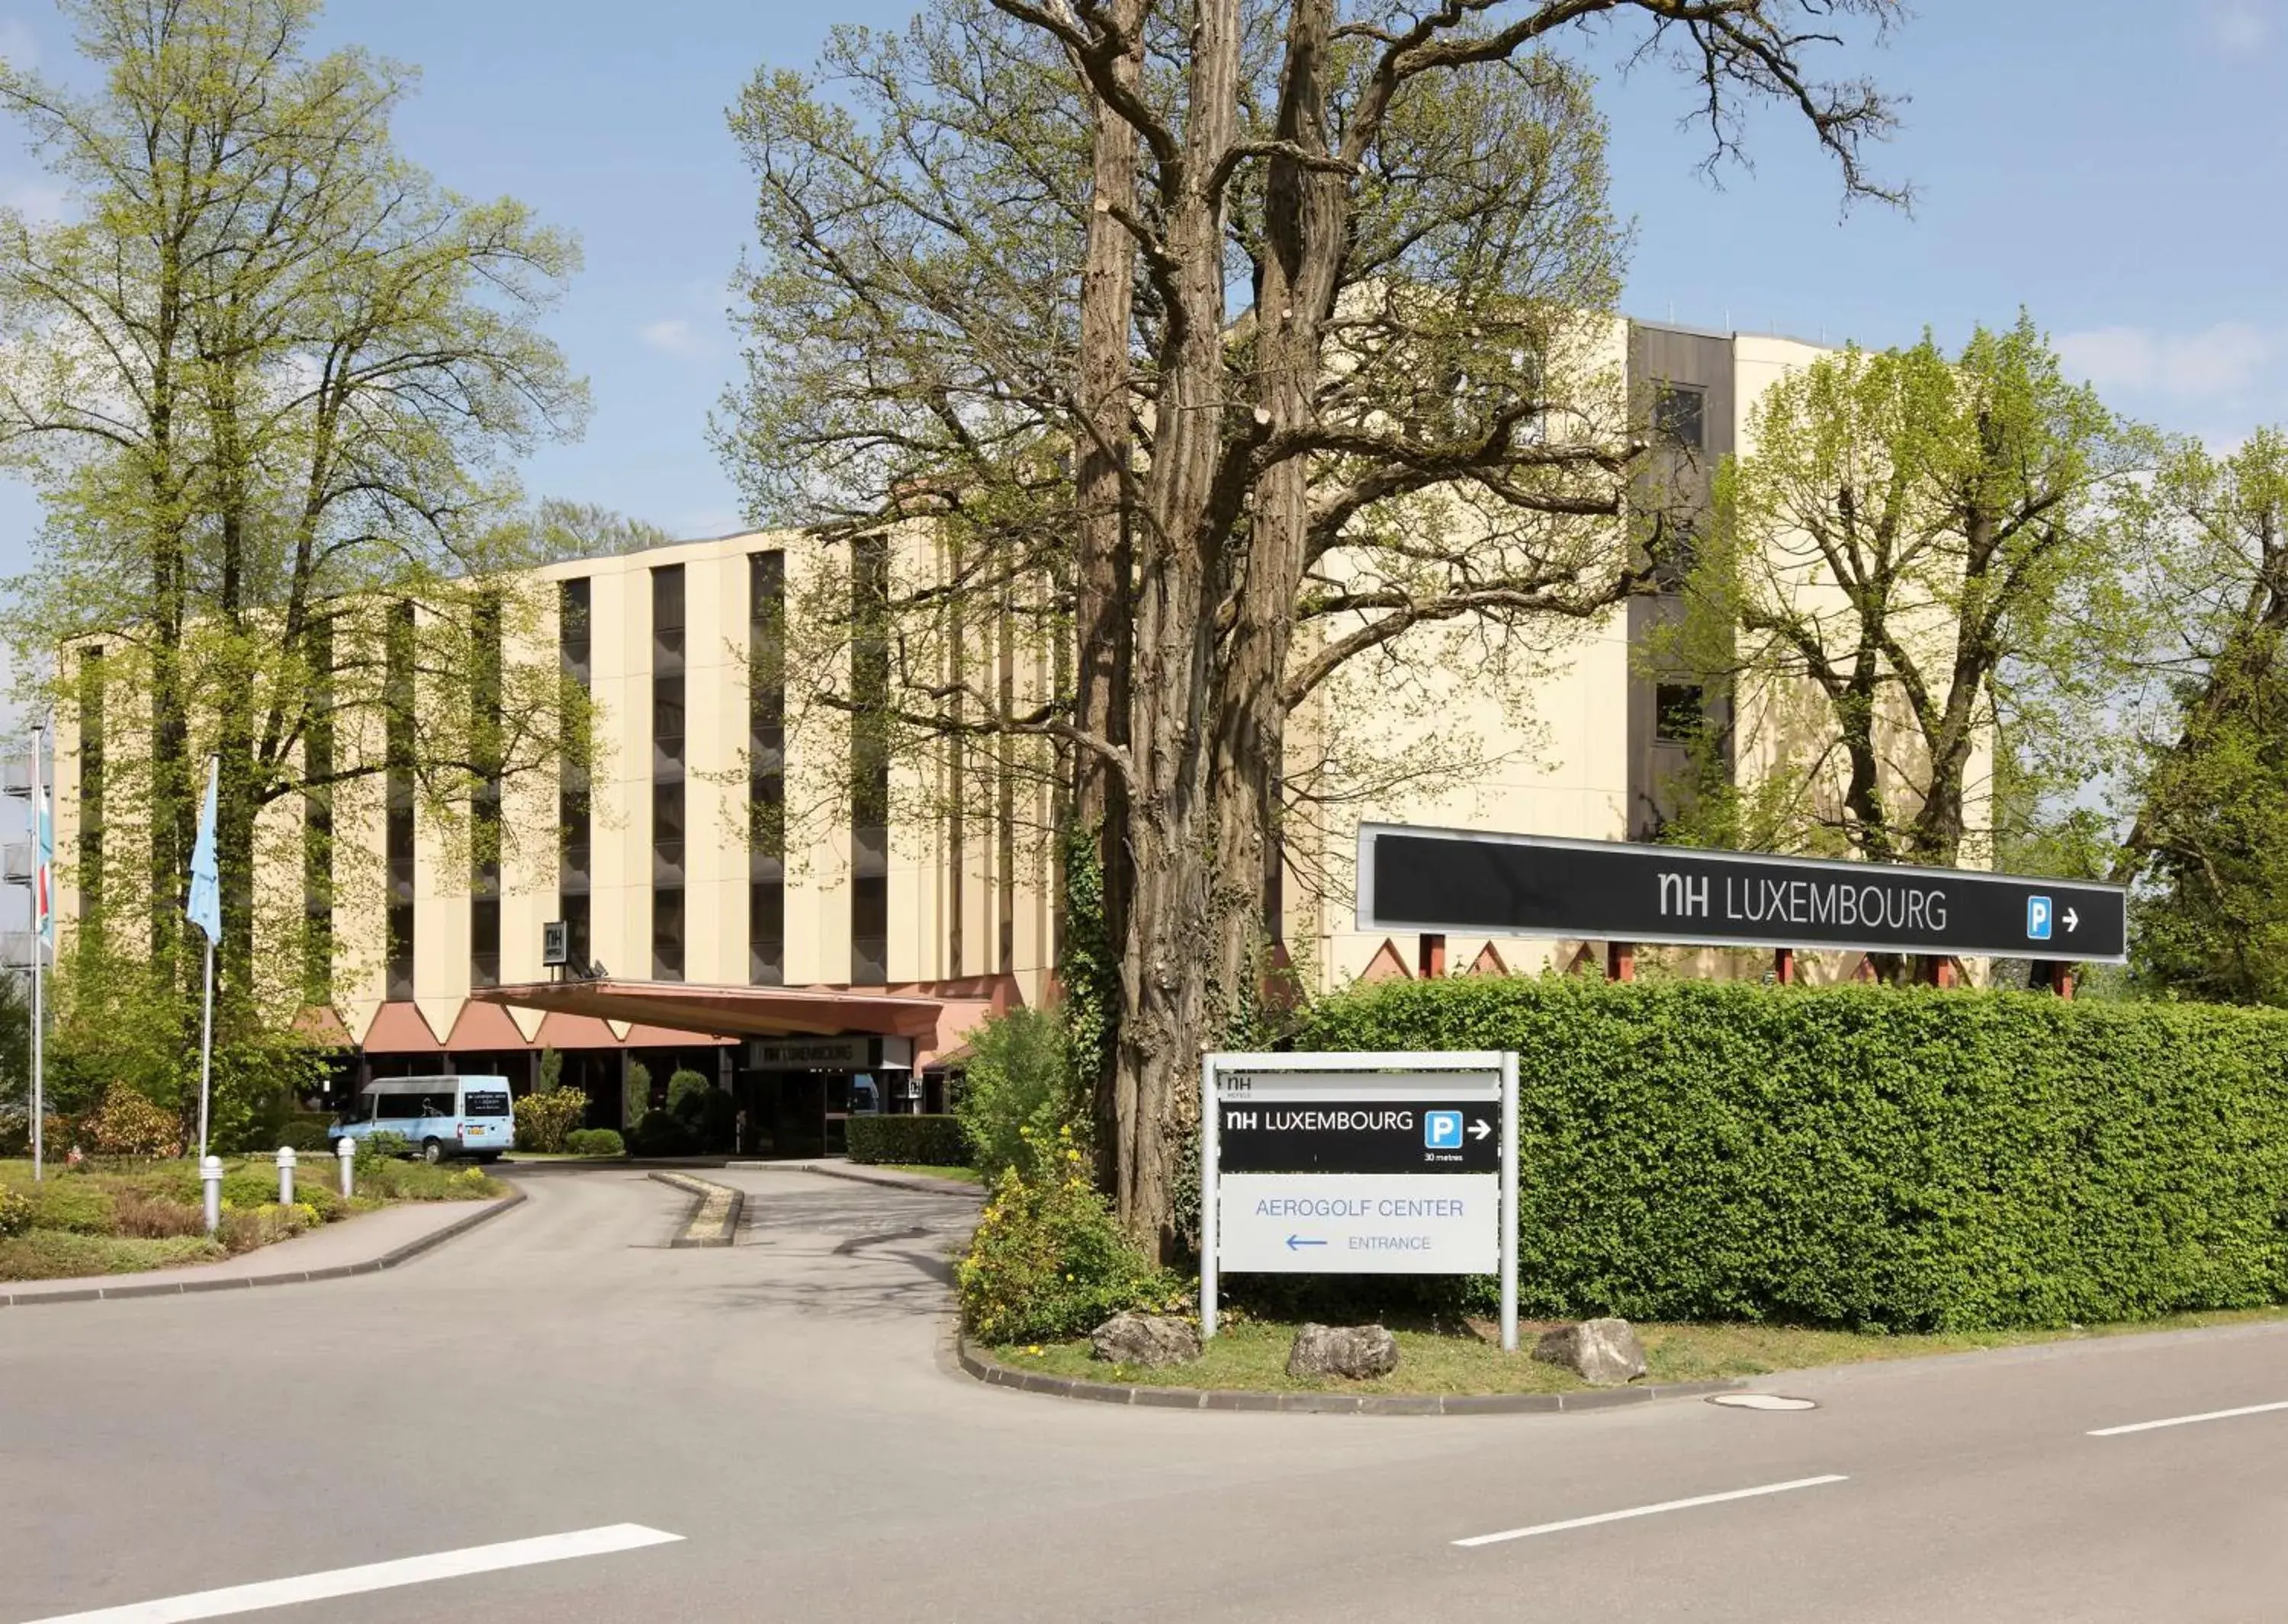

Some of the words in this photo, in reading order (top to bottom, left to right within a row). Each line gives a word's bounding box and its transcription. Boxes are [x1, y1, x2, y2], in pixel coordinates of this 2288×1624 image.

[1727, 876, 1947, 931] LUXEMBOURG
[2032, 902, 2048, 932] P
[1265, 1111, 1413, 1131] LUXEMBOURG
[1432, 1117, 1454, 1143] P
[1255, 1199, 1373, 1217] AEROGOLF
[1378, 1199, 1464, 1217] CENTER
[1348, 1236, 1432, 1250] ENTRANCE
